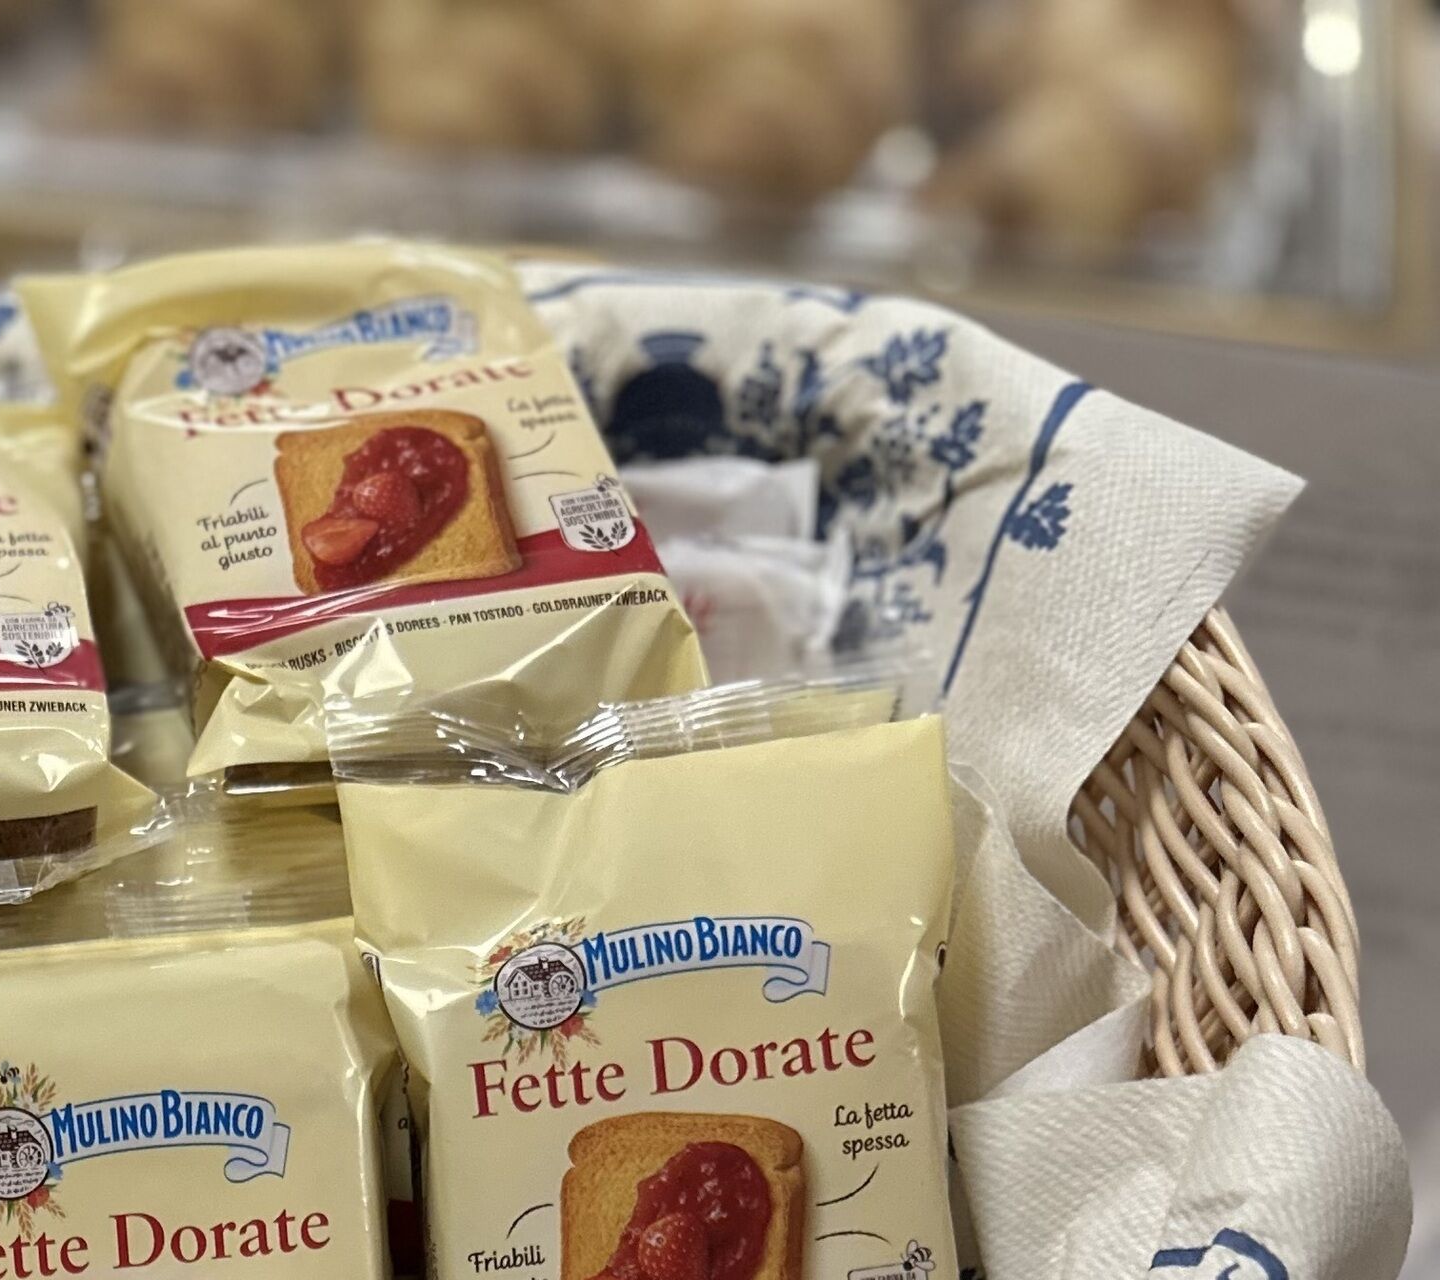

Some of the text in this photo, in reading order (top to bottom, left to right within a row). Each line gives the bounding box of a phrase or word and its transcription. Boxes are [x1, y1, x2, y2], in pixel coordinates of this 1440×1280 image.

[195, 507, 269, 532] Friabili
[560, 498, 619, 517] AGRICOLTURA
[563, 508, 625, 528] SOSTENIBILE
[201, 524, 278, 554] al punto
[217, 543, 273, 571] giusto
[288, 648, 327, 672] RUSKS
[396, 618, 440, 635] DOREES
[449, 611, 471, 626] PAN
[474, 605, 524, 623] TOSTADO
[532, 593, 612, 616] GOLDBRAUNER
[29, 700, 88, 714] ZWIEBACK
[583, 916, 802, 986] MULINO BIANCO
[467, 1025, 877, 1119] Fette Dorate
[51, 1089, 264, 1157] MULINO BIANCO
[833, 1101, 913, 1134] La fetta
[841, 1131, 910, 1160] spessa
[109, 1207, 331, 1269] Dorate
[467, 1246, 545, 1273] Friabili
